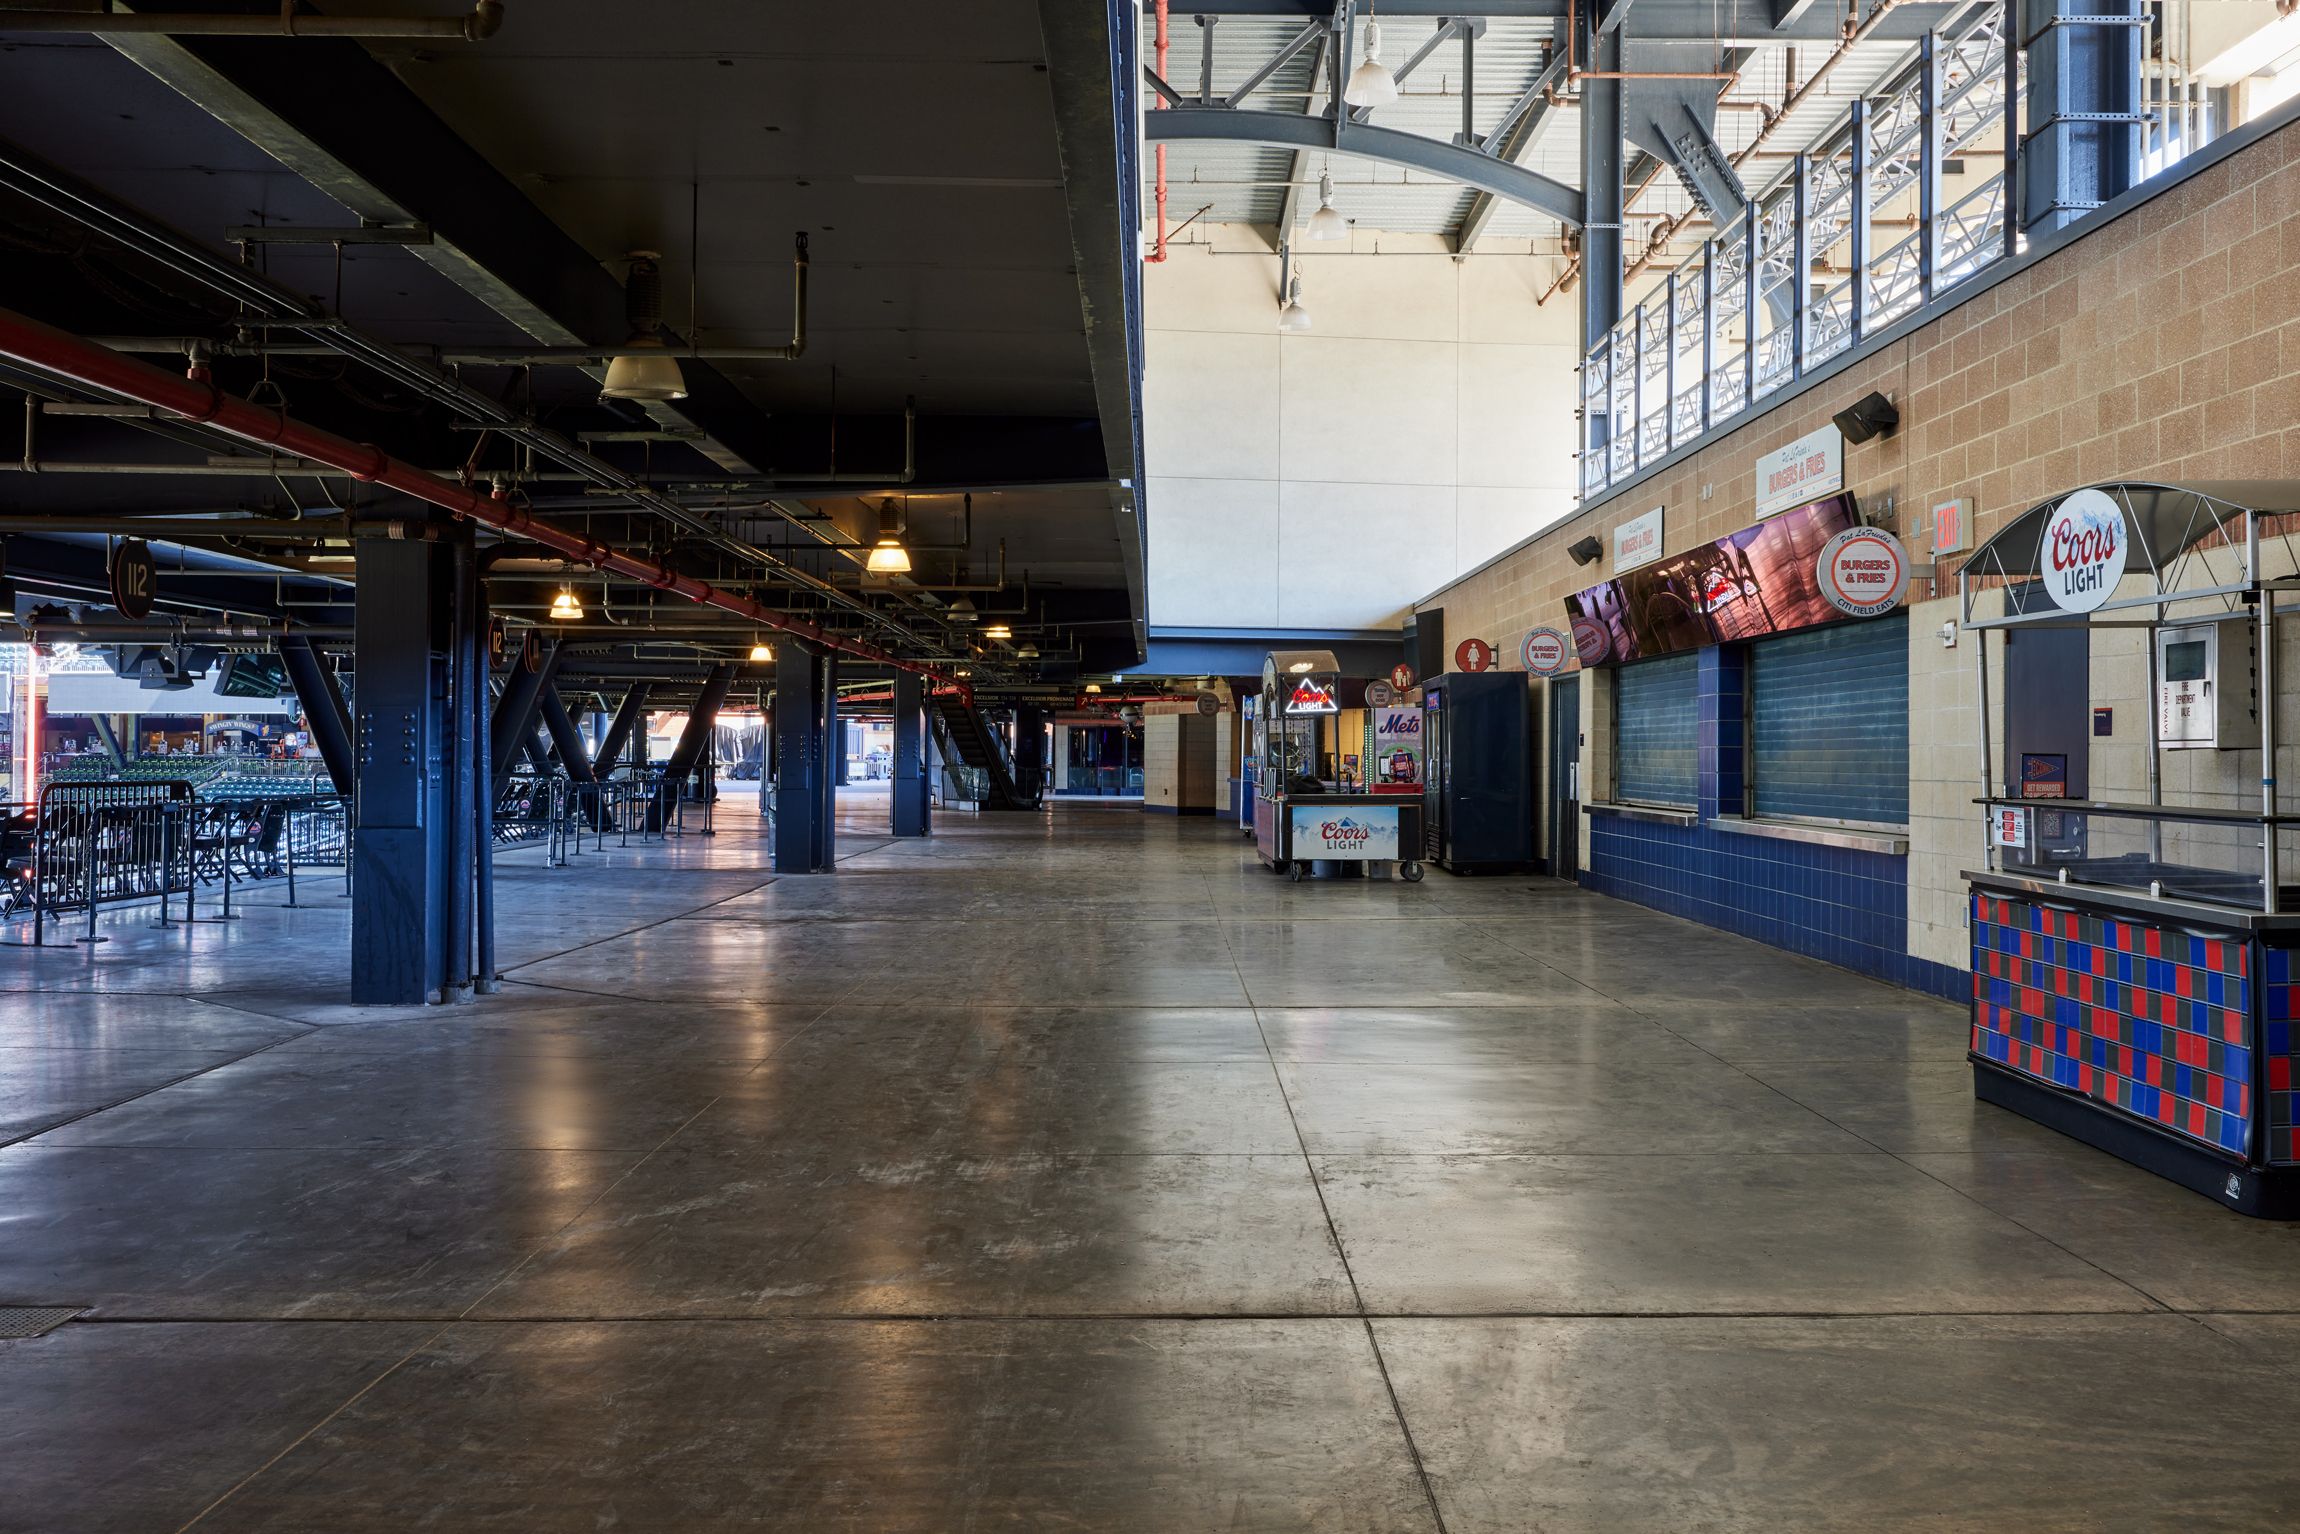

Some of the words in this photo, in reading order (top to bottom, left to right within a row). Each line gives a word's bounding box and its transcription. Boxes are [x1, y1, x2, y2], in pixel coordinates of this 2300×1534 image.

[1769, 463, 1798, 494] BURGERS
[1799, 461, 1805, 481] &
[1806, 451, 1825, 479] FRIES
[1937, 506, 1957, 549] EXIT
[1840, 533, 1853, 544] Pat
[2052, 518, 2116, 571] Coors
[1841, 560, 1890, 570] BURGERS
[128, 562, 147, 597] 112
[1845, 573, 1855, 583] &
[1857, 573, 1886, 583] FRIES
[2064, 563, 2104, 596] LIGHT
[1837, 598, 1852, 610] CITI
[1853, 606, 1875, 615] FIELD
[1877, 598, 1895, 612] EATS
[493, 631, 502, 653] 112
[1292, 688, 1329, 704] Coors
[1299, 702, 1322, 710] LIGHT
[1380, 714, 1420, 734] Mets
[2027, 784, 2035, 792] GET
[2036, 784, 2061, 792] REWARDED
[1321, 822, 1370, 840] Coors
[1327, 841, 1364, 850] LIGHT
